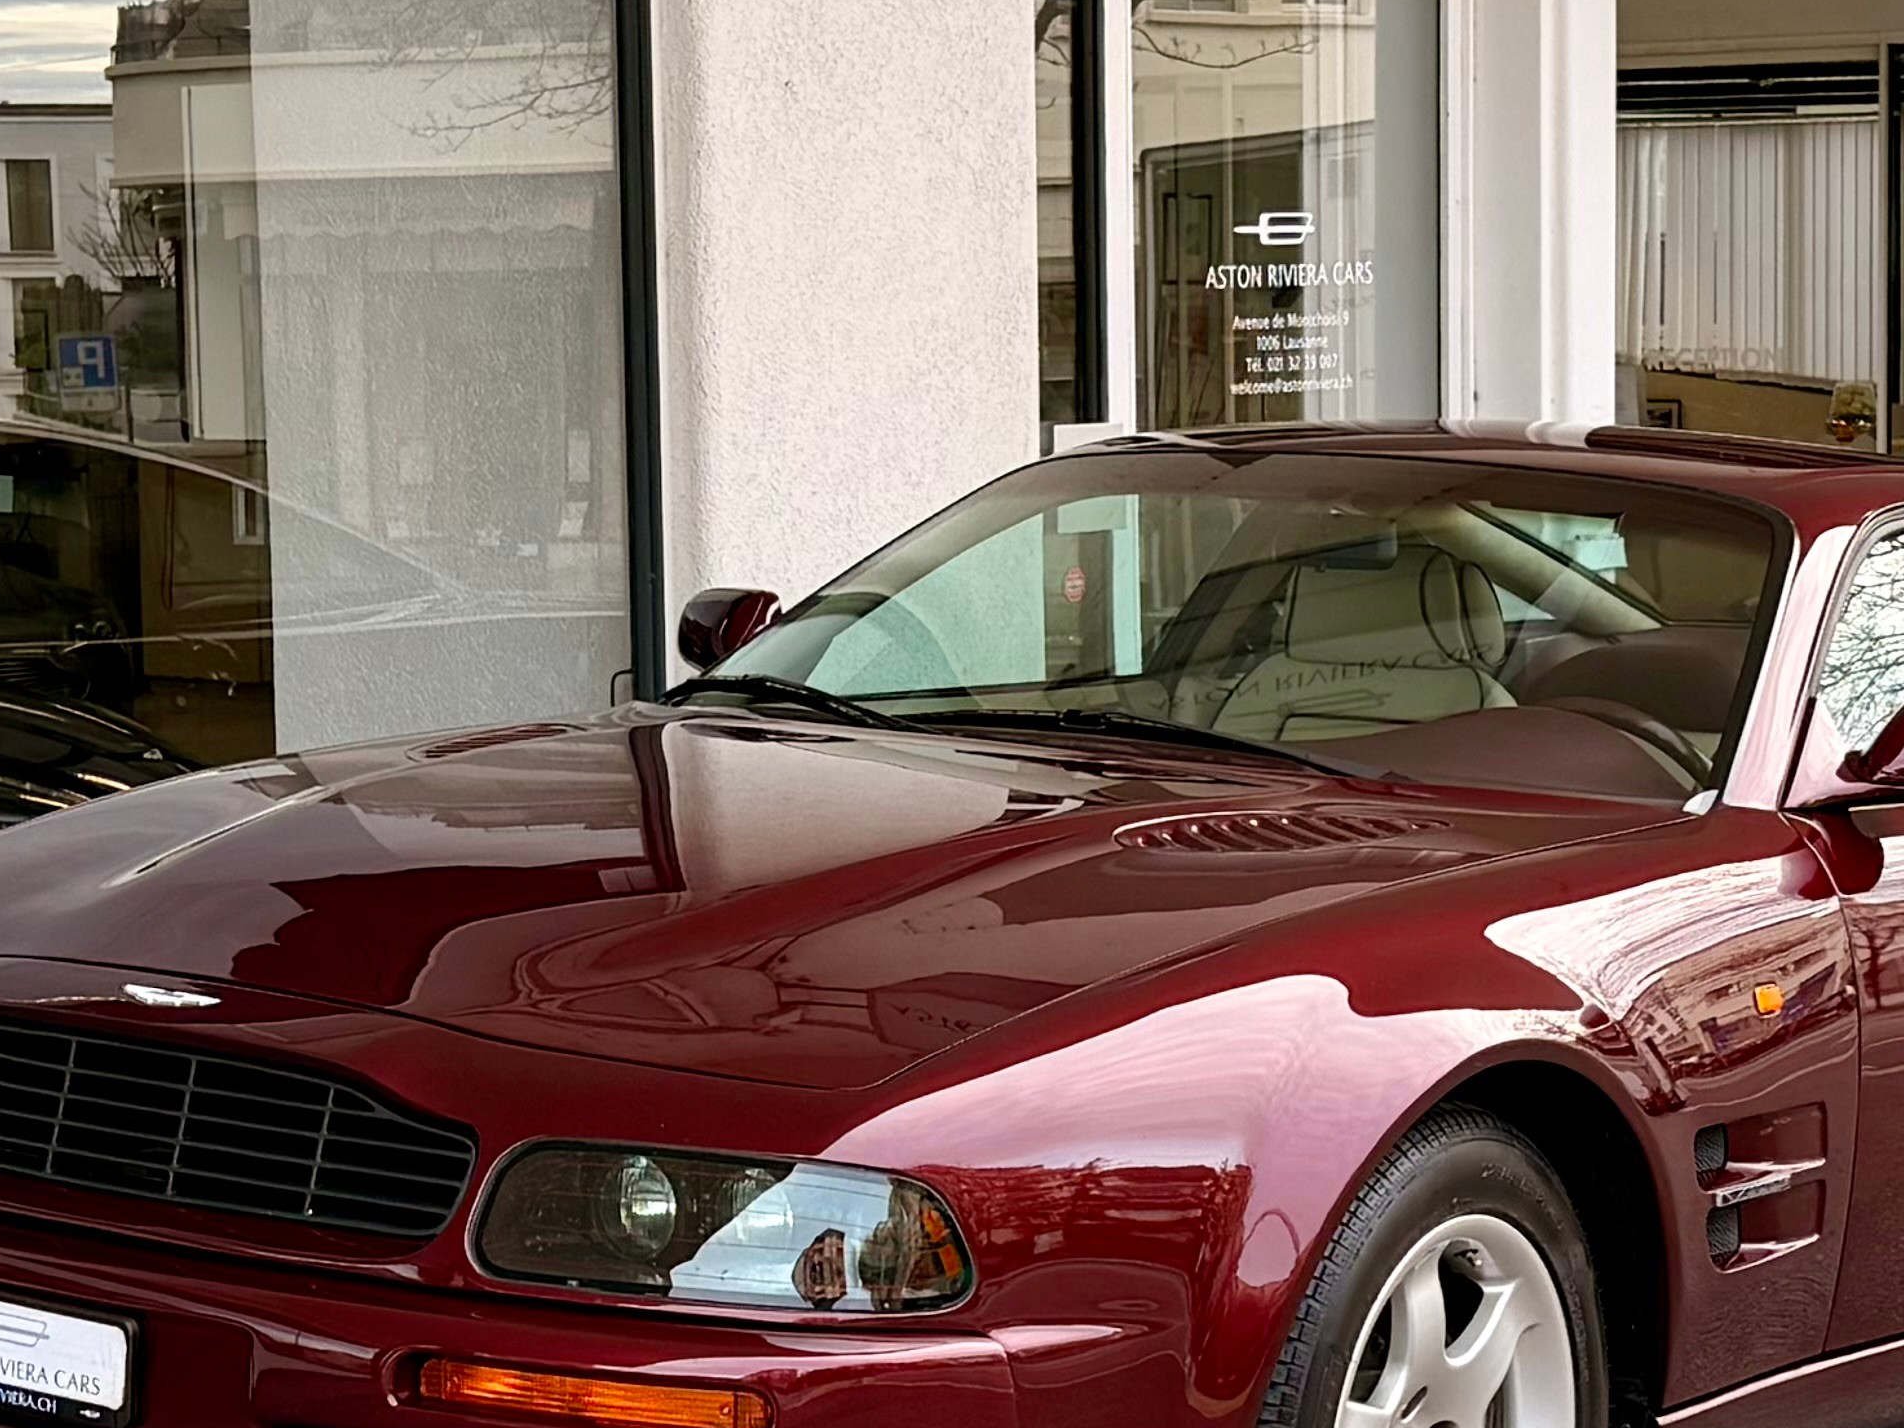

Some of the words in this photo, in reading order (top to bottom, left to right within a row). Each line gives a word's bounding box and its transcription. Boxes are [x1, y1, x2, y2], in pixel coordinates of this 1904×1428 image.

[1205, 264, 1262, 289] ASTON
[1268, 262, 1329, 289] RIVIERA
[1333, 260, 1374, 286] CARS
[1232, 315, 1270, 330] Avenue
[1272, 313, 1285, 329] de
[1283, 335, 1329, 350] Lausanne
[54, 1369, 102, 1397] CARS
